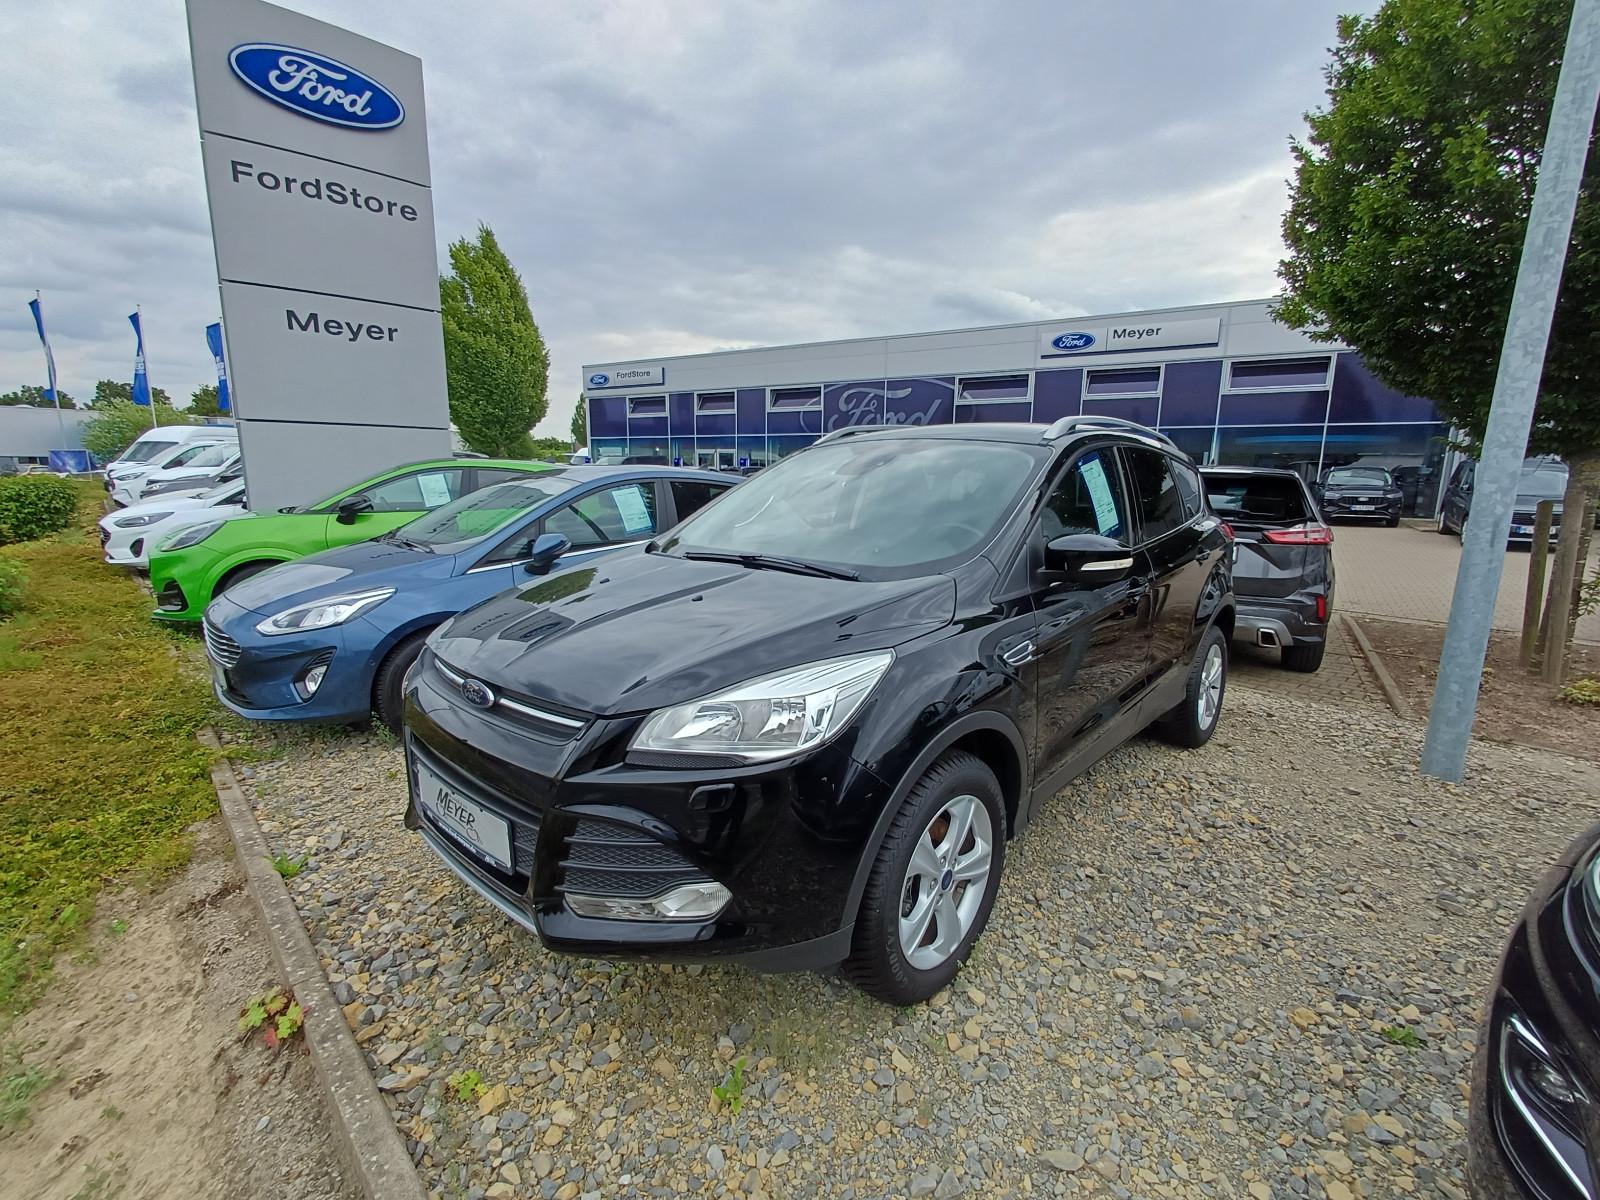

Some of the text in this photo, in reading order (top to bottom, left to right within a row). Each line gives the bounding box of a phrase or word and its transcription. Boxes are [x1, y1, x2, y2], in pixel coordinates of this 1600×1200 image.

[268, 55, 373, 116] Ford
[230, 159, 418, 222] FordStore
[285, 309, 399, 342] Meyer
[1059, 335, 1086, 348] Ford
[1112, 327, 1162, 340] Meyer
[616, 370, 651, 379] FordStore
[436, 788, 476, 829] MEYER
